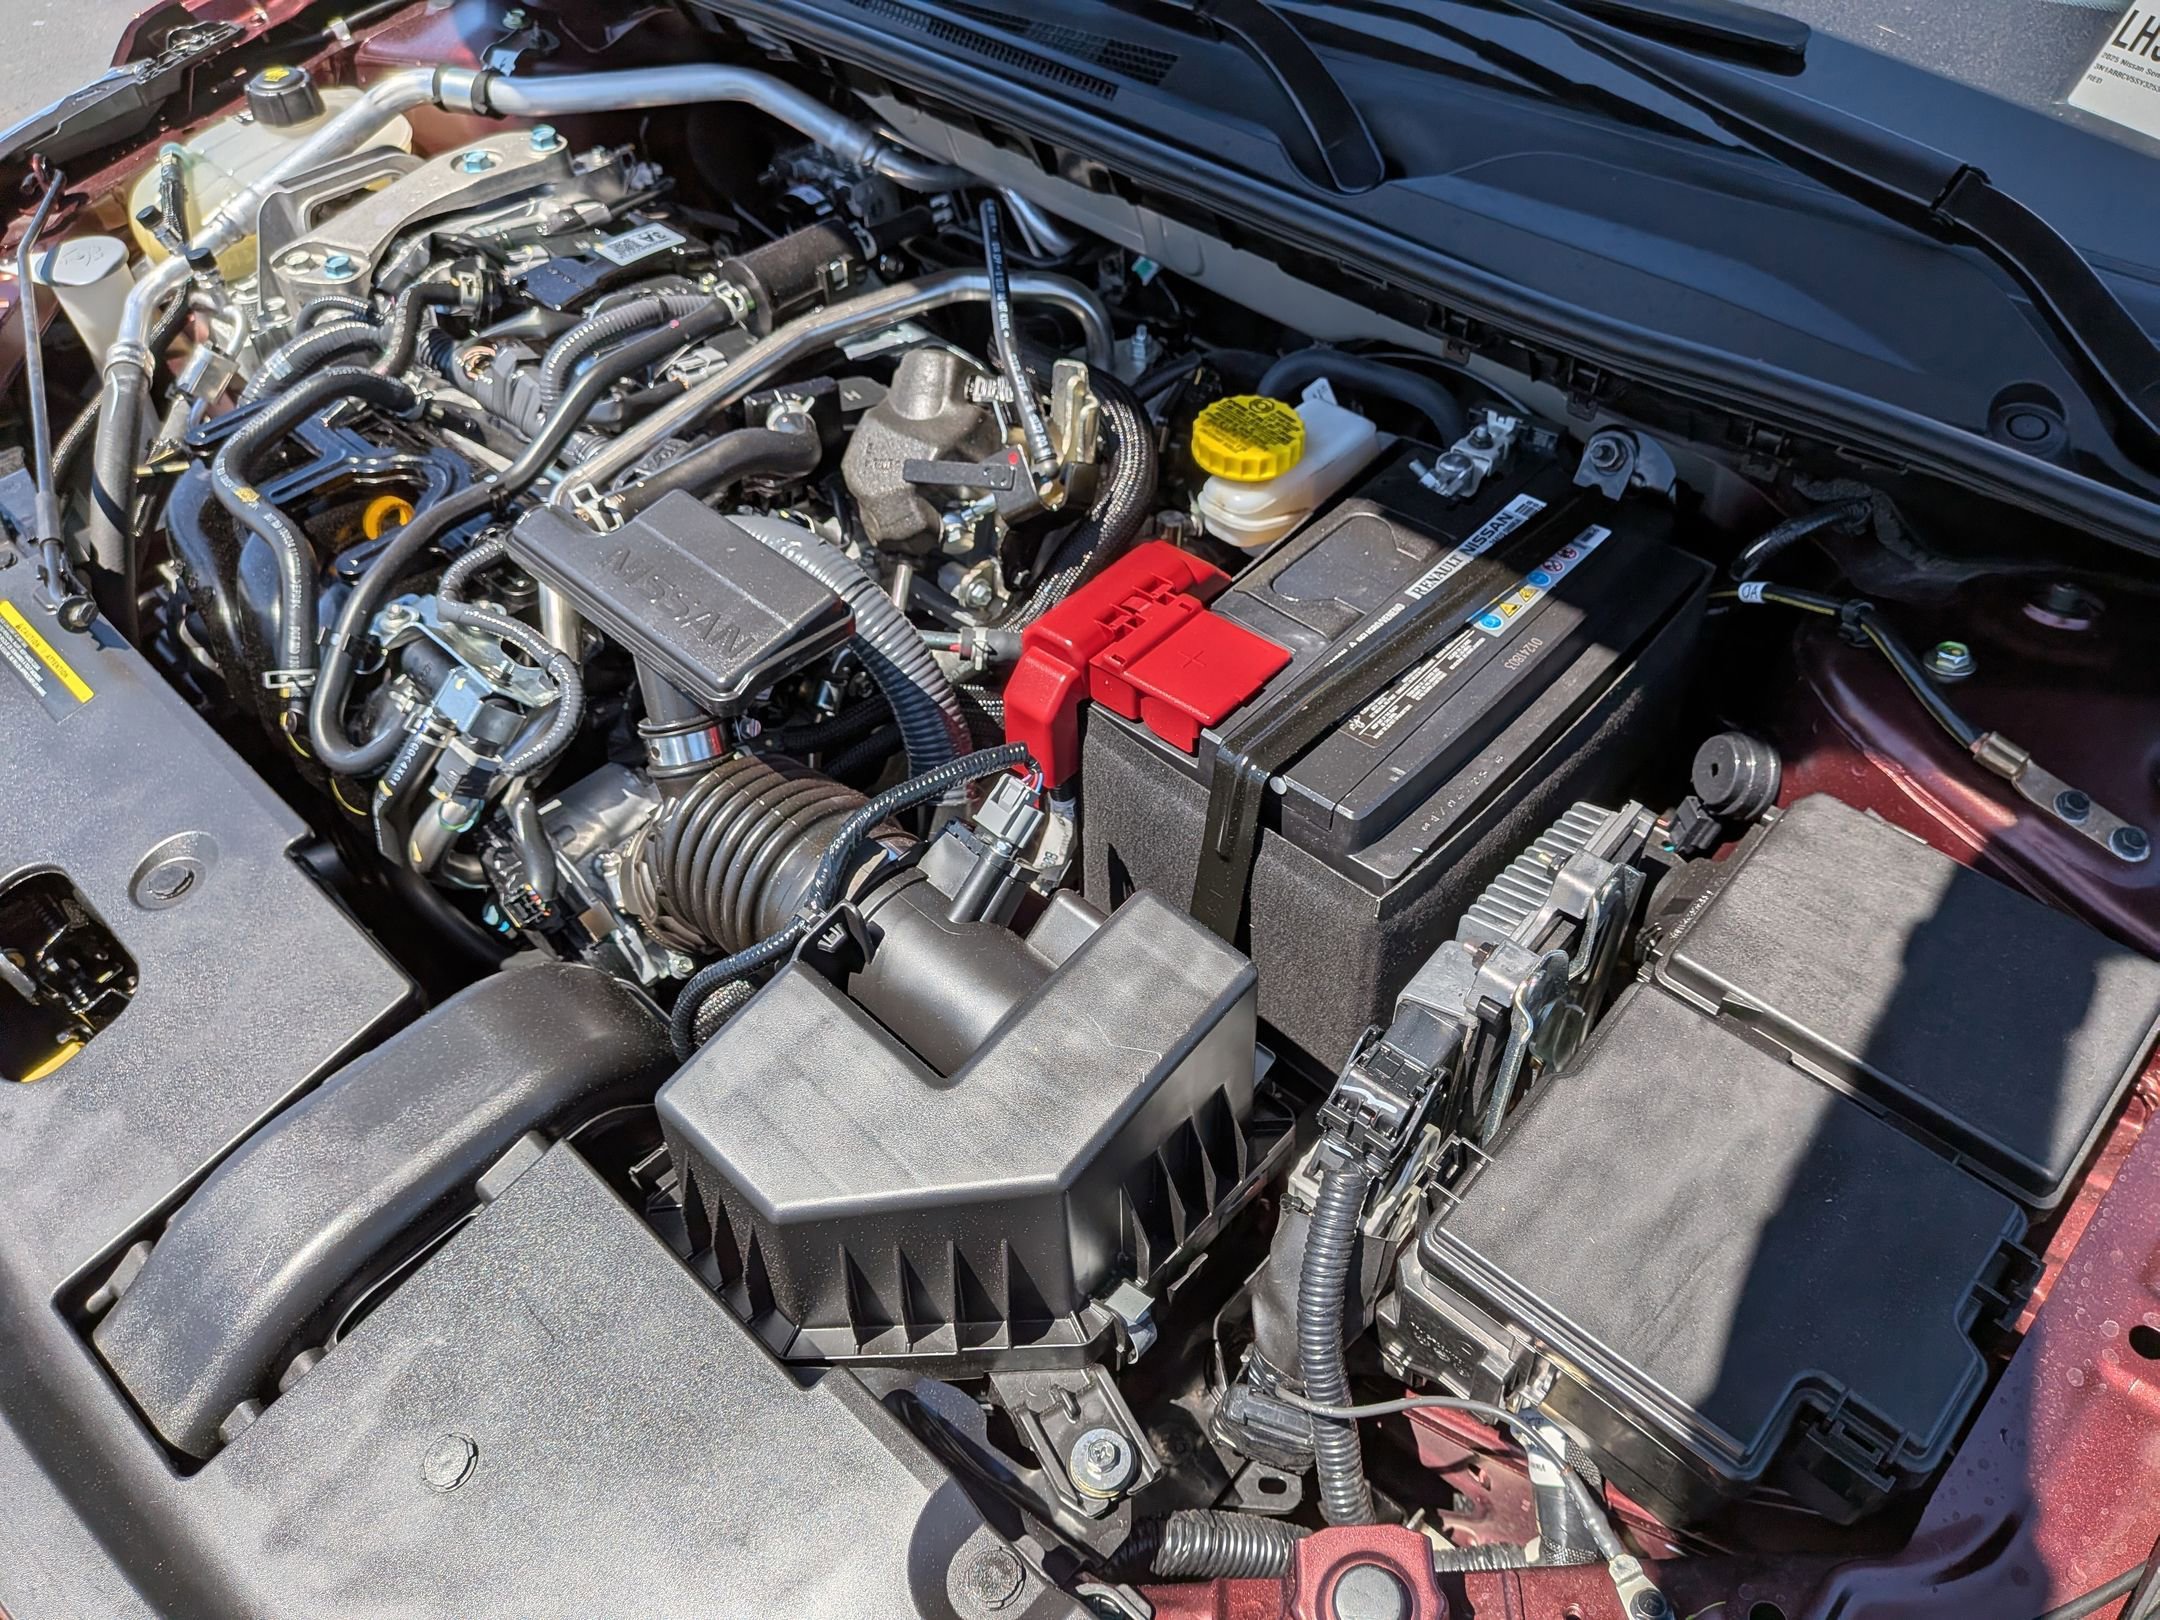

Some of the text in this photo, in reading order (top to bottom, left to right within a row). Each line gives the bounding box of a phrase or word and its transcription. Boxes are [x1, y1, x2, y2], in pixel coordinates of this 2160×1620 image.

[2086, 73, 2103, 85] RED
[2101, 51, 2120, 63] 2025
[2120, 58, 2145, 73] Nissan
[1412, 555, 1461, 598] RENAULT
[1462, 512, 1513, 555] NISSAN
[603, 549, 756, 658] NISSAN
